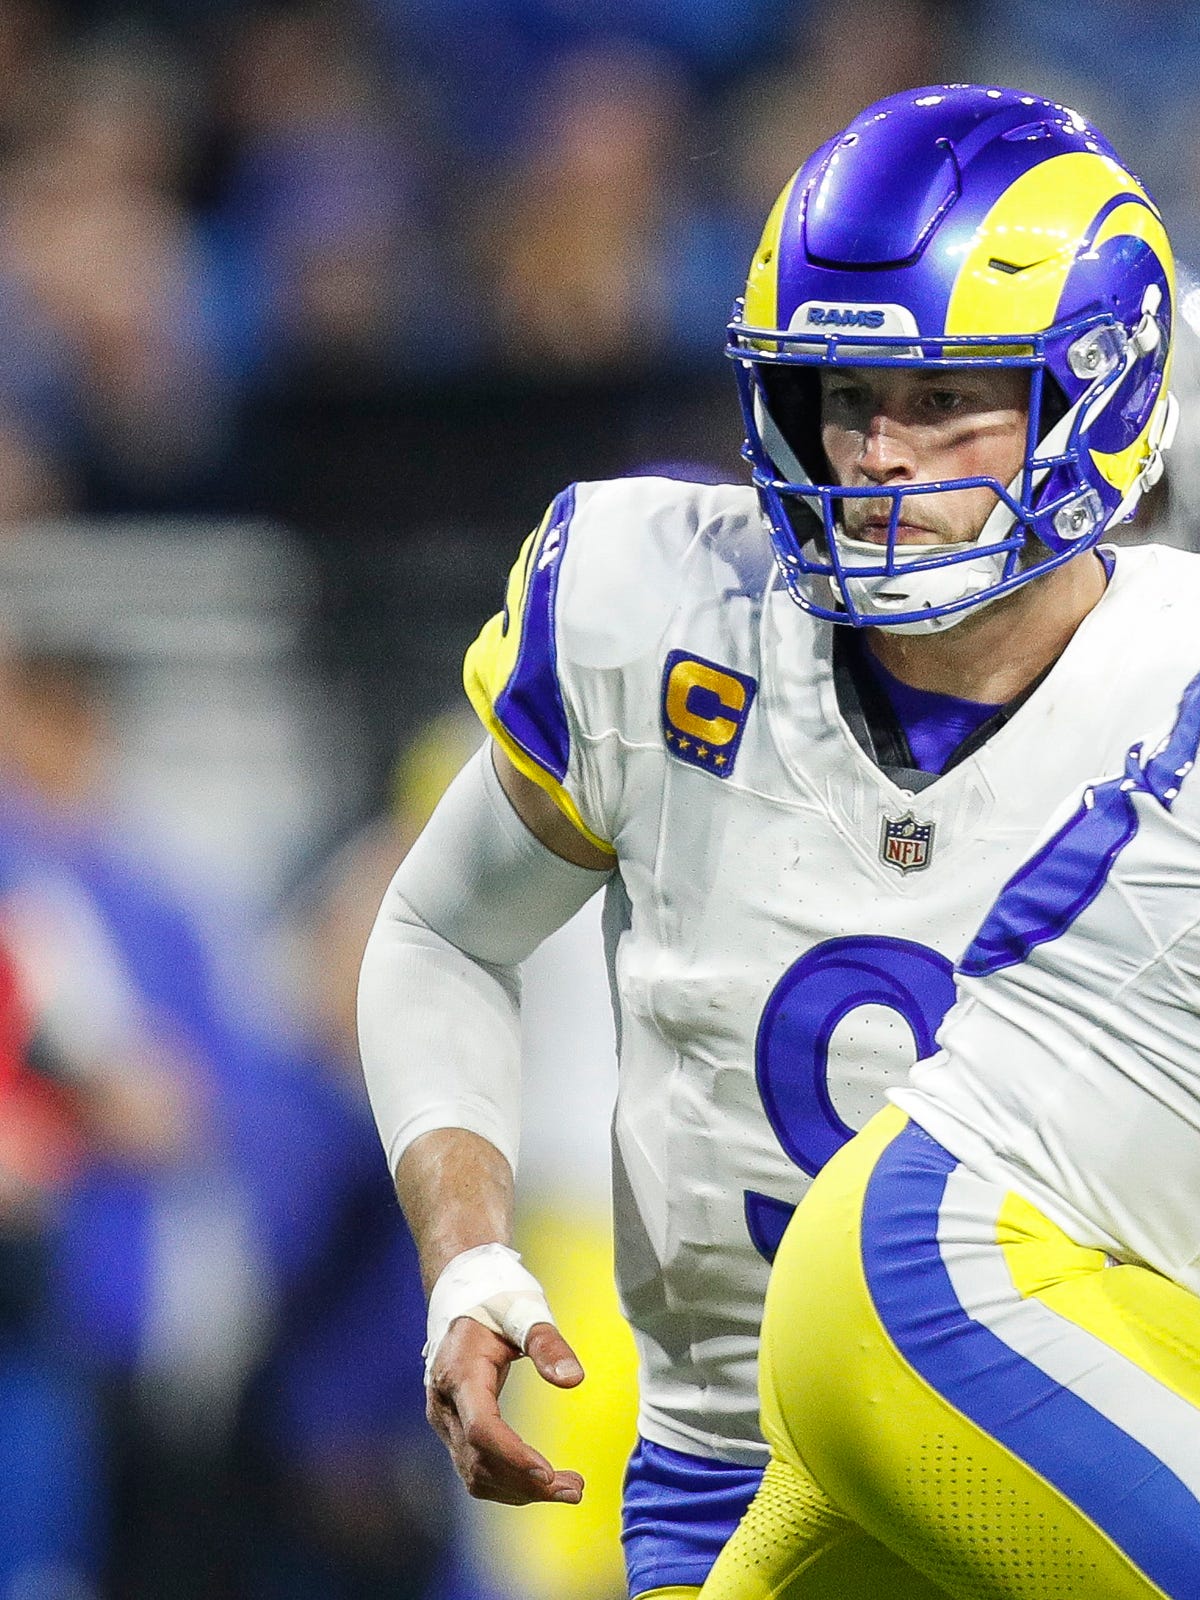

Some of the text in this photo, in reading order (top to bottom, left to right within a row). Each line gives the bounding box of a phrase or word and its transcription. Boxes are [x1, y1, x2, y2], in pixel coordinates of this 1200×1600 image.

[806, 307, 885, 329] RAMS
[666, 660, 746, 747] C
[887, 839, 924, 865] NFL
